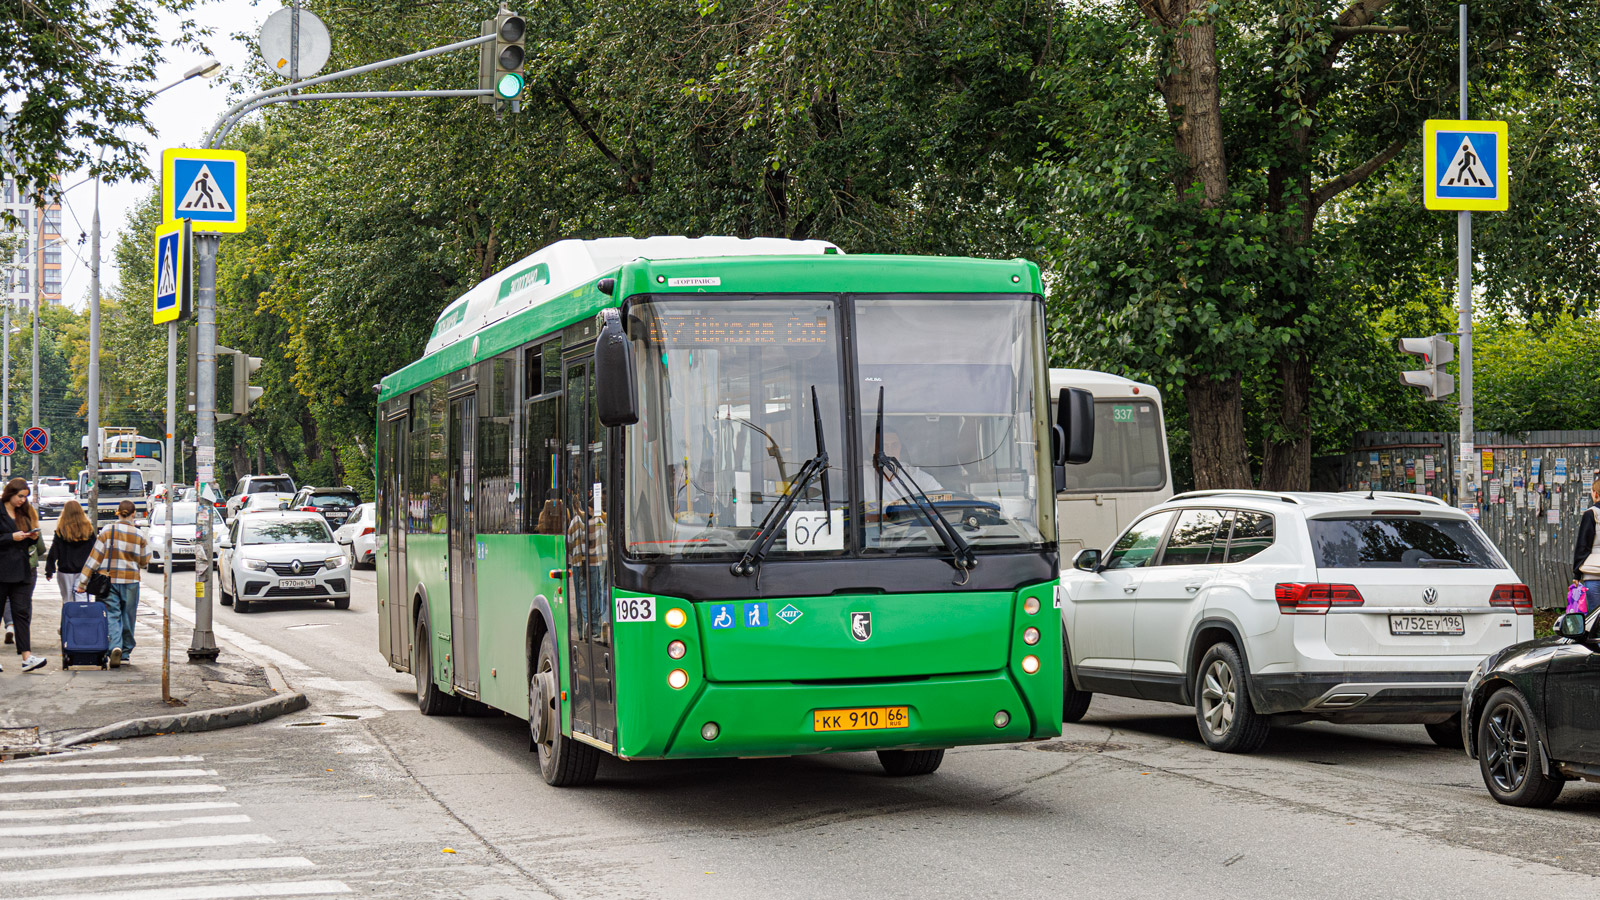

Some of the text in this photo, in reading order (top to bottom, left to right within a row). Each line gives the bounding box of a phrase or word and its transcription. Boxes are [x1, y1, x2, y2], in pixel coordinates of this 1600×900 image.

[1113, 408, 1133, 421] 337
[794, 516, 829, 546] 67
[616, 599, 652, 620] 1963
[781, 610, 799, 618] КПГ
[1394, 616, 1461, 631] М752ЕУ 196
[822, 708, 903, 729] КК 910 66
